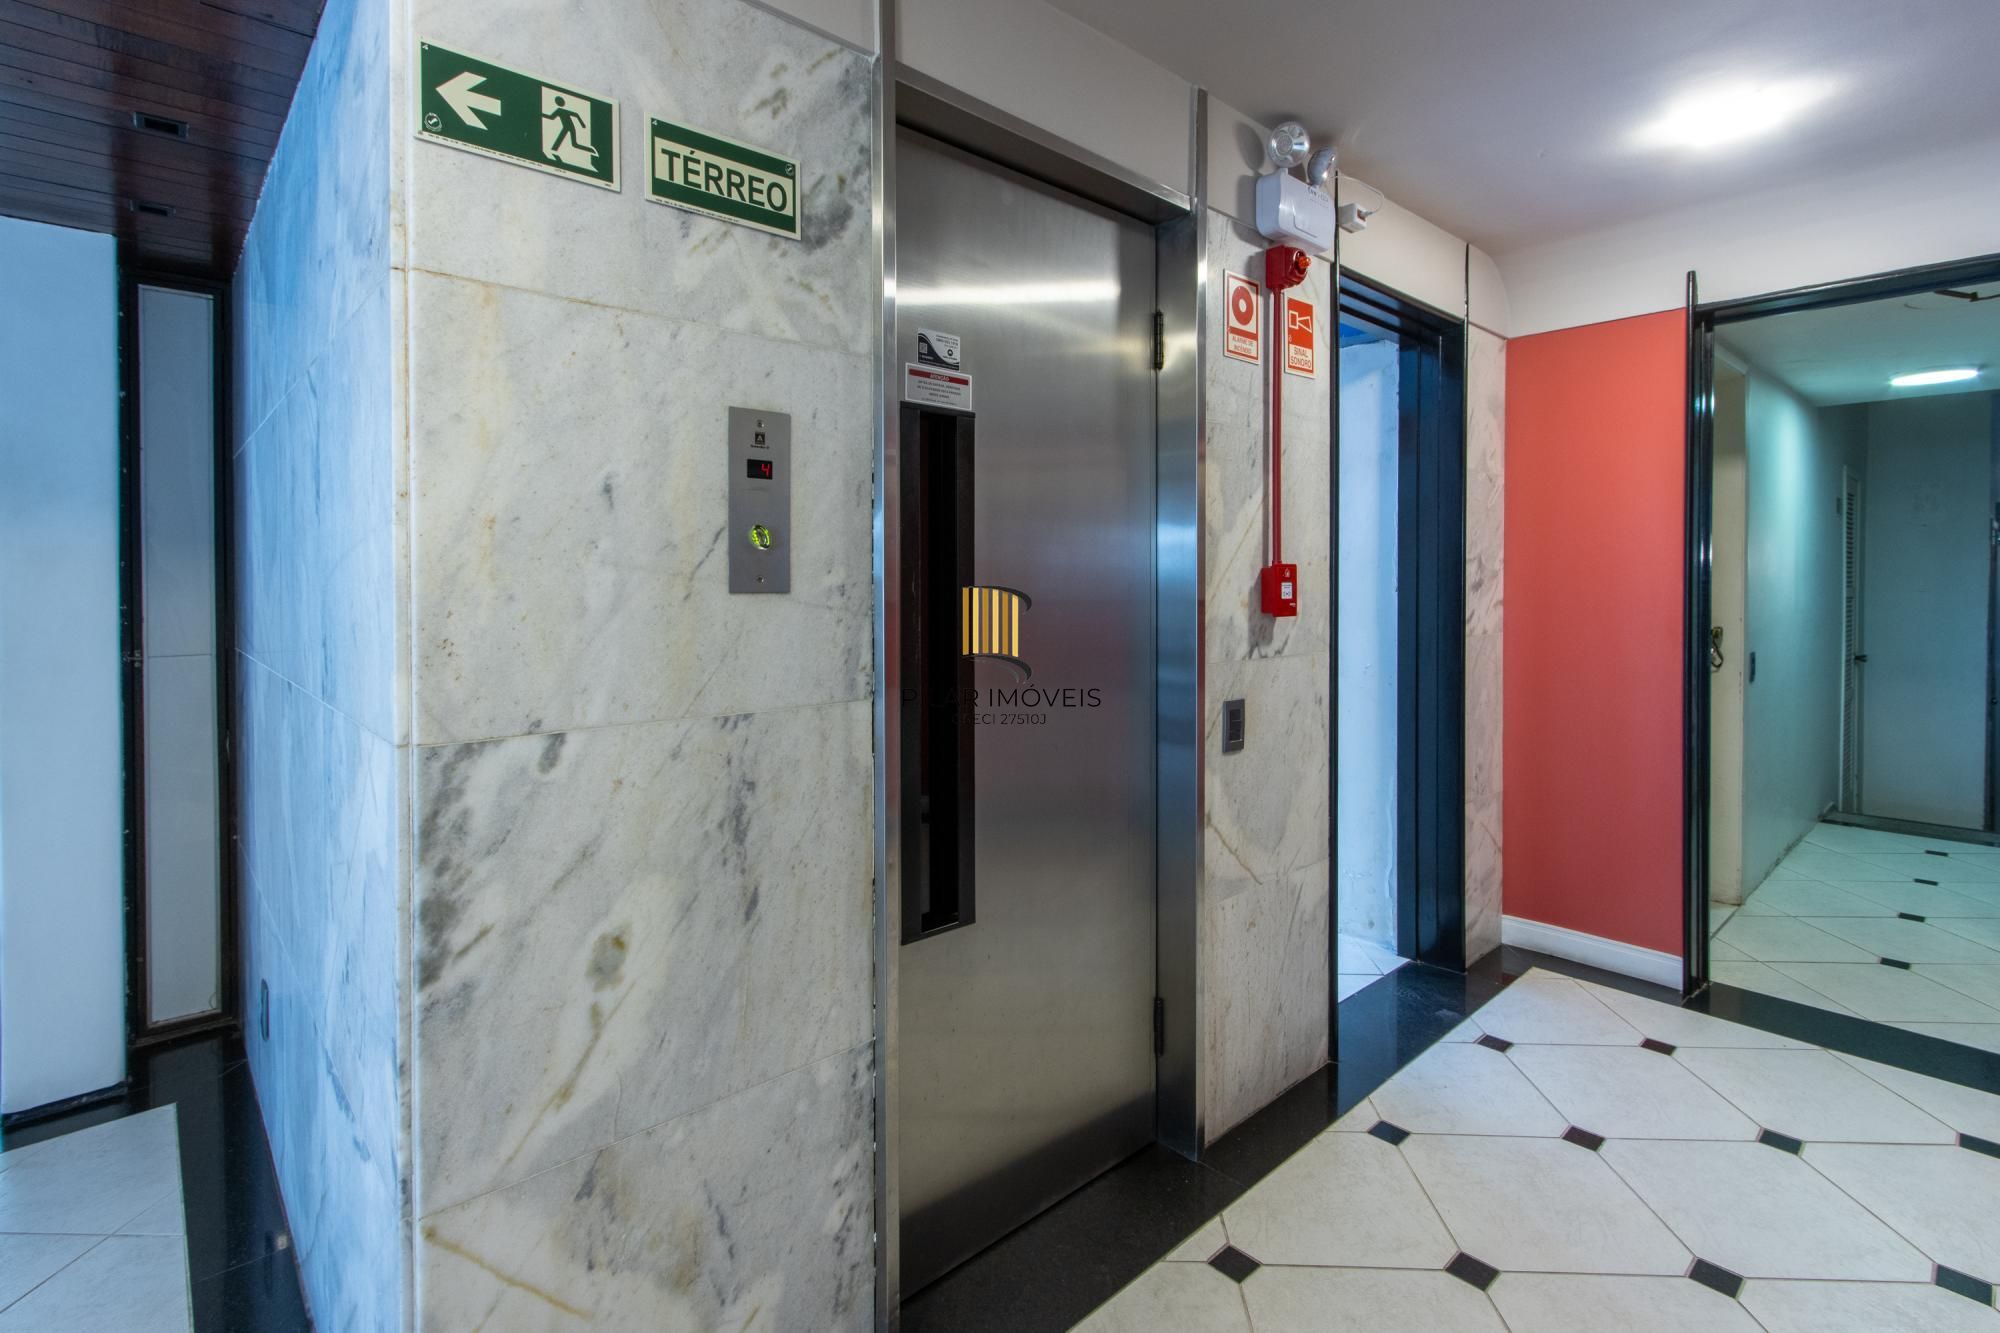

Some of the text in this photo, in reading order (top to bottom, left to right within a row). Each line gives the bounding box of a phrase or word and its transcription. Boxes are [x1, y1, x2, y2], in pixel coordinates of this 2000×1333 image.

[661, 148, 788, 212] TÉRREO
[1232, 335, 1248, 346] ALARME
[1294, 347, 1308, 358] SINAL
[1290, 356, 1312, 368] SONORO
[761, 463, 770, 477] 4
